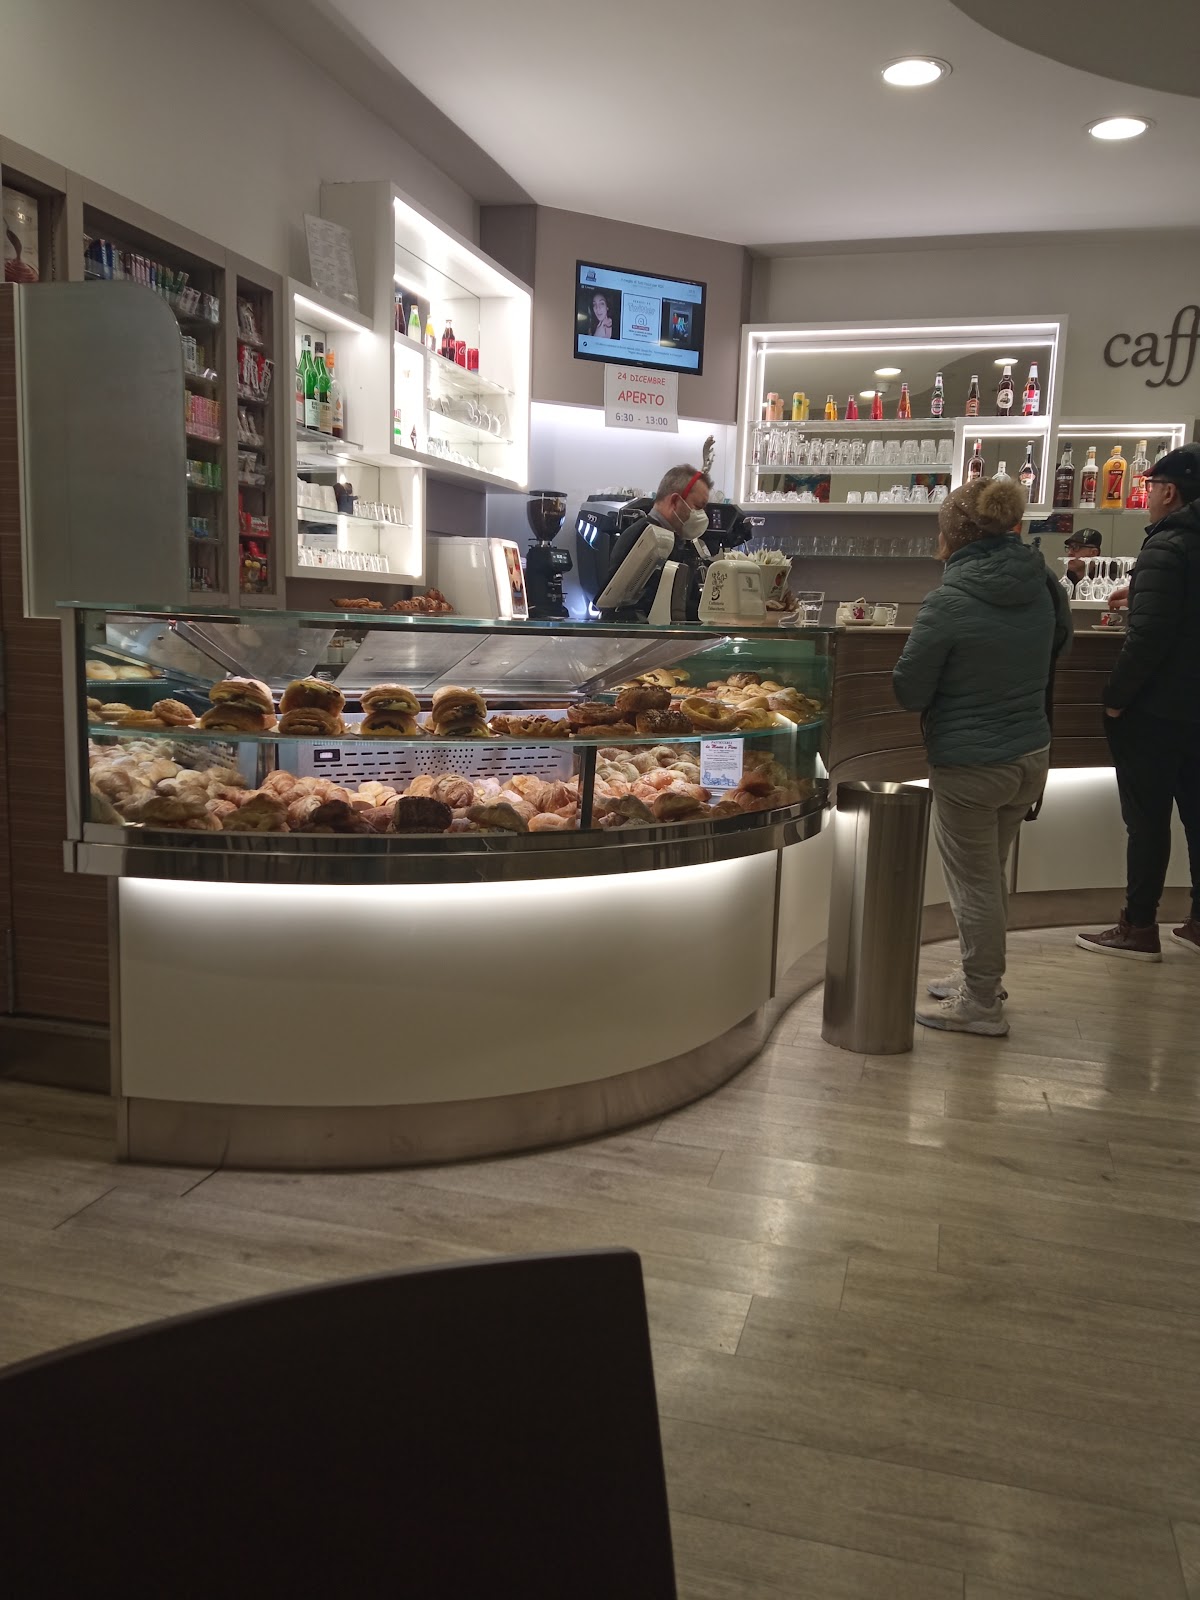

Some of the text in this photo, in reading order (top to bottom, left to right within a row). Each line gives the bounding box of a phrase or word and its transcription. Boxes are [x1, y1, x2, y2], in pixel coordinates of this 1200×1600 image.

[617, 372, 666, 386] 24 DICEMBRE
[617, 390, 665, 406] APERTO
[615, 412, 634, 423] 6:30
[645, 415, 669, 426] 13:00
